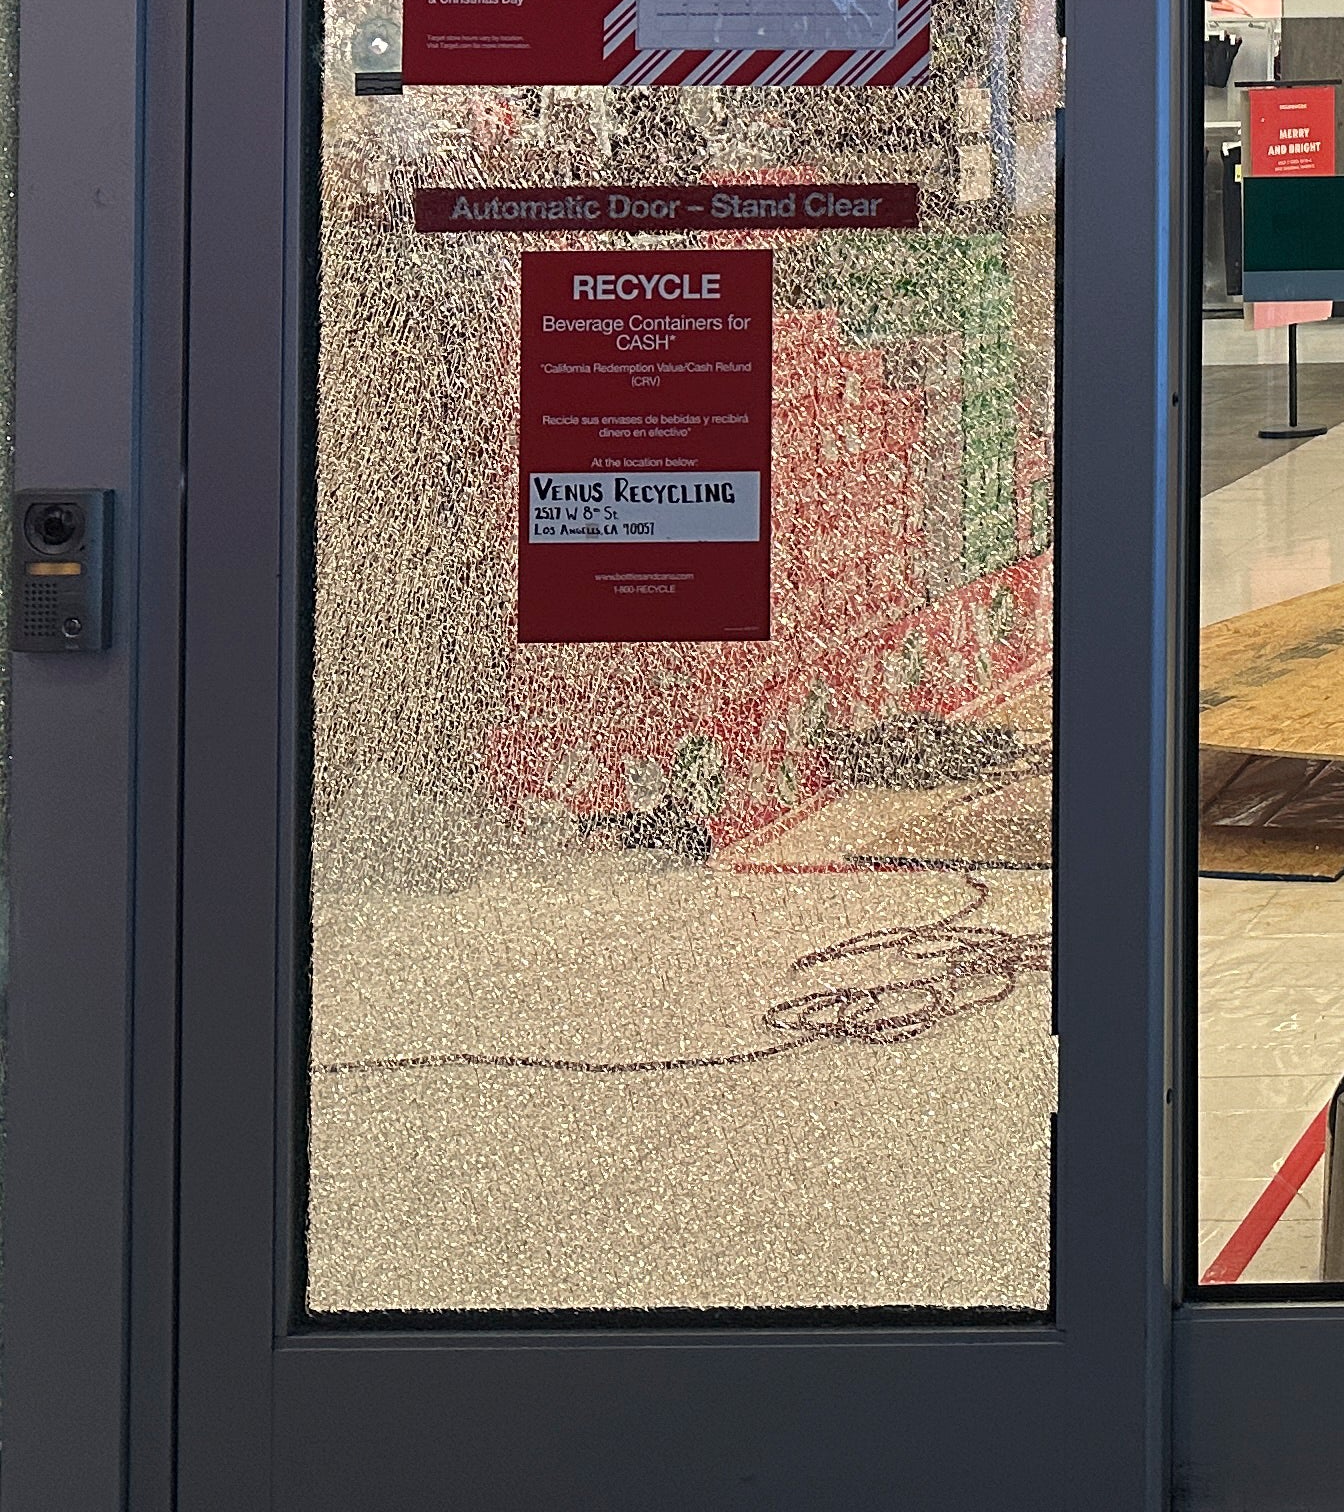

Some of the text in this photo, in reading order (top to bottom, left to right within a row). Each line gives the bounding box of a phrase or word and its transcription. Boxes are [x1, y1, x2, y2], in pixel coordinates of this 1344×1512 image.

[1279, 128, 1310, 140] MERRY
[1268, 144, 1287, 156] AND
[450, 195, 601, 220] Automatic
[608, 194, 680, 219] Door
[711, 193, 795, 218] Stand
[804, 191, 883, 217] Clear
[573, 274, 721, 300] RECYCLE
[542, 314, 751, 335] Beverage Containers for
[593, 362, 654, 374] Redemption
[715, 361, 752, 372] Refund
[631, 376, 660, 388] (CRV)
[542, 415, 580, 426] Recicle
[581, 416, 600, 425] sus
[601, 416, 643, 425] envases
[644, 415, 659, 425] de
[660, 414, 701, 425] bebidas
[703, 416, 710, 426] y
[599, 427, 631, 437] dinero
[633, 428, 646, 437] en
[591, 457, 699, 468] At the location below:
[533, 476, 736, 504] VENUS RECYCLING
[534, 506, 561, 520] 2517
[565, 507, 578, 520] W
[603, 505, 619, 520] St
[604, 524, 618, 535] CA
